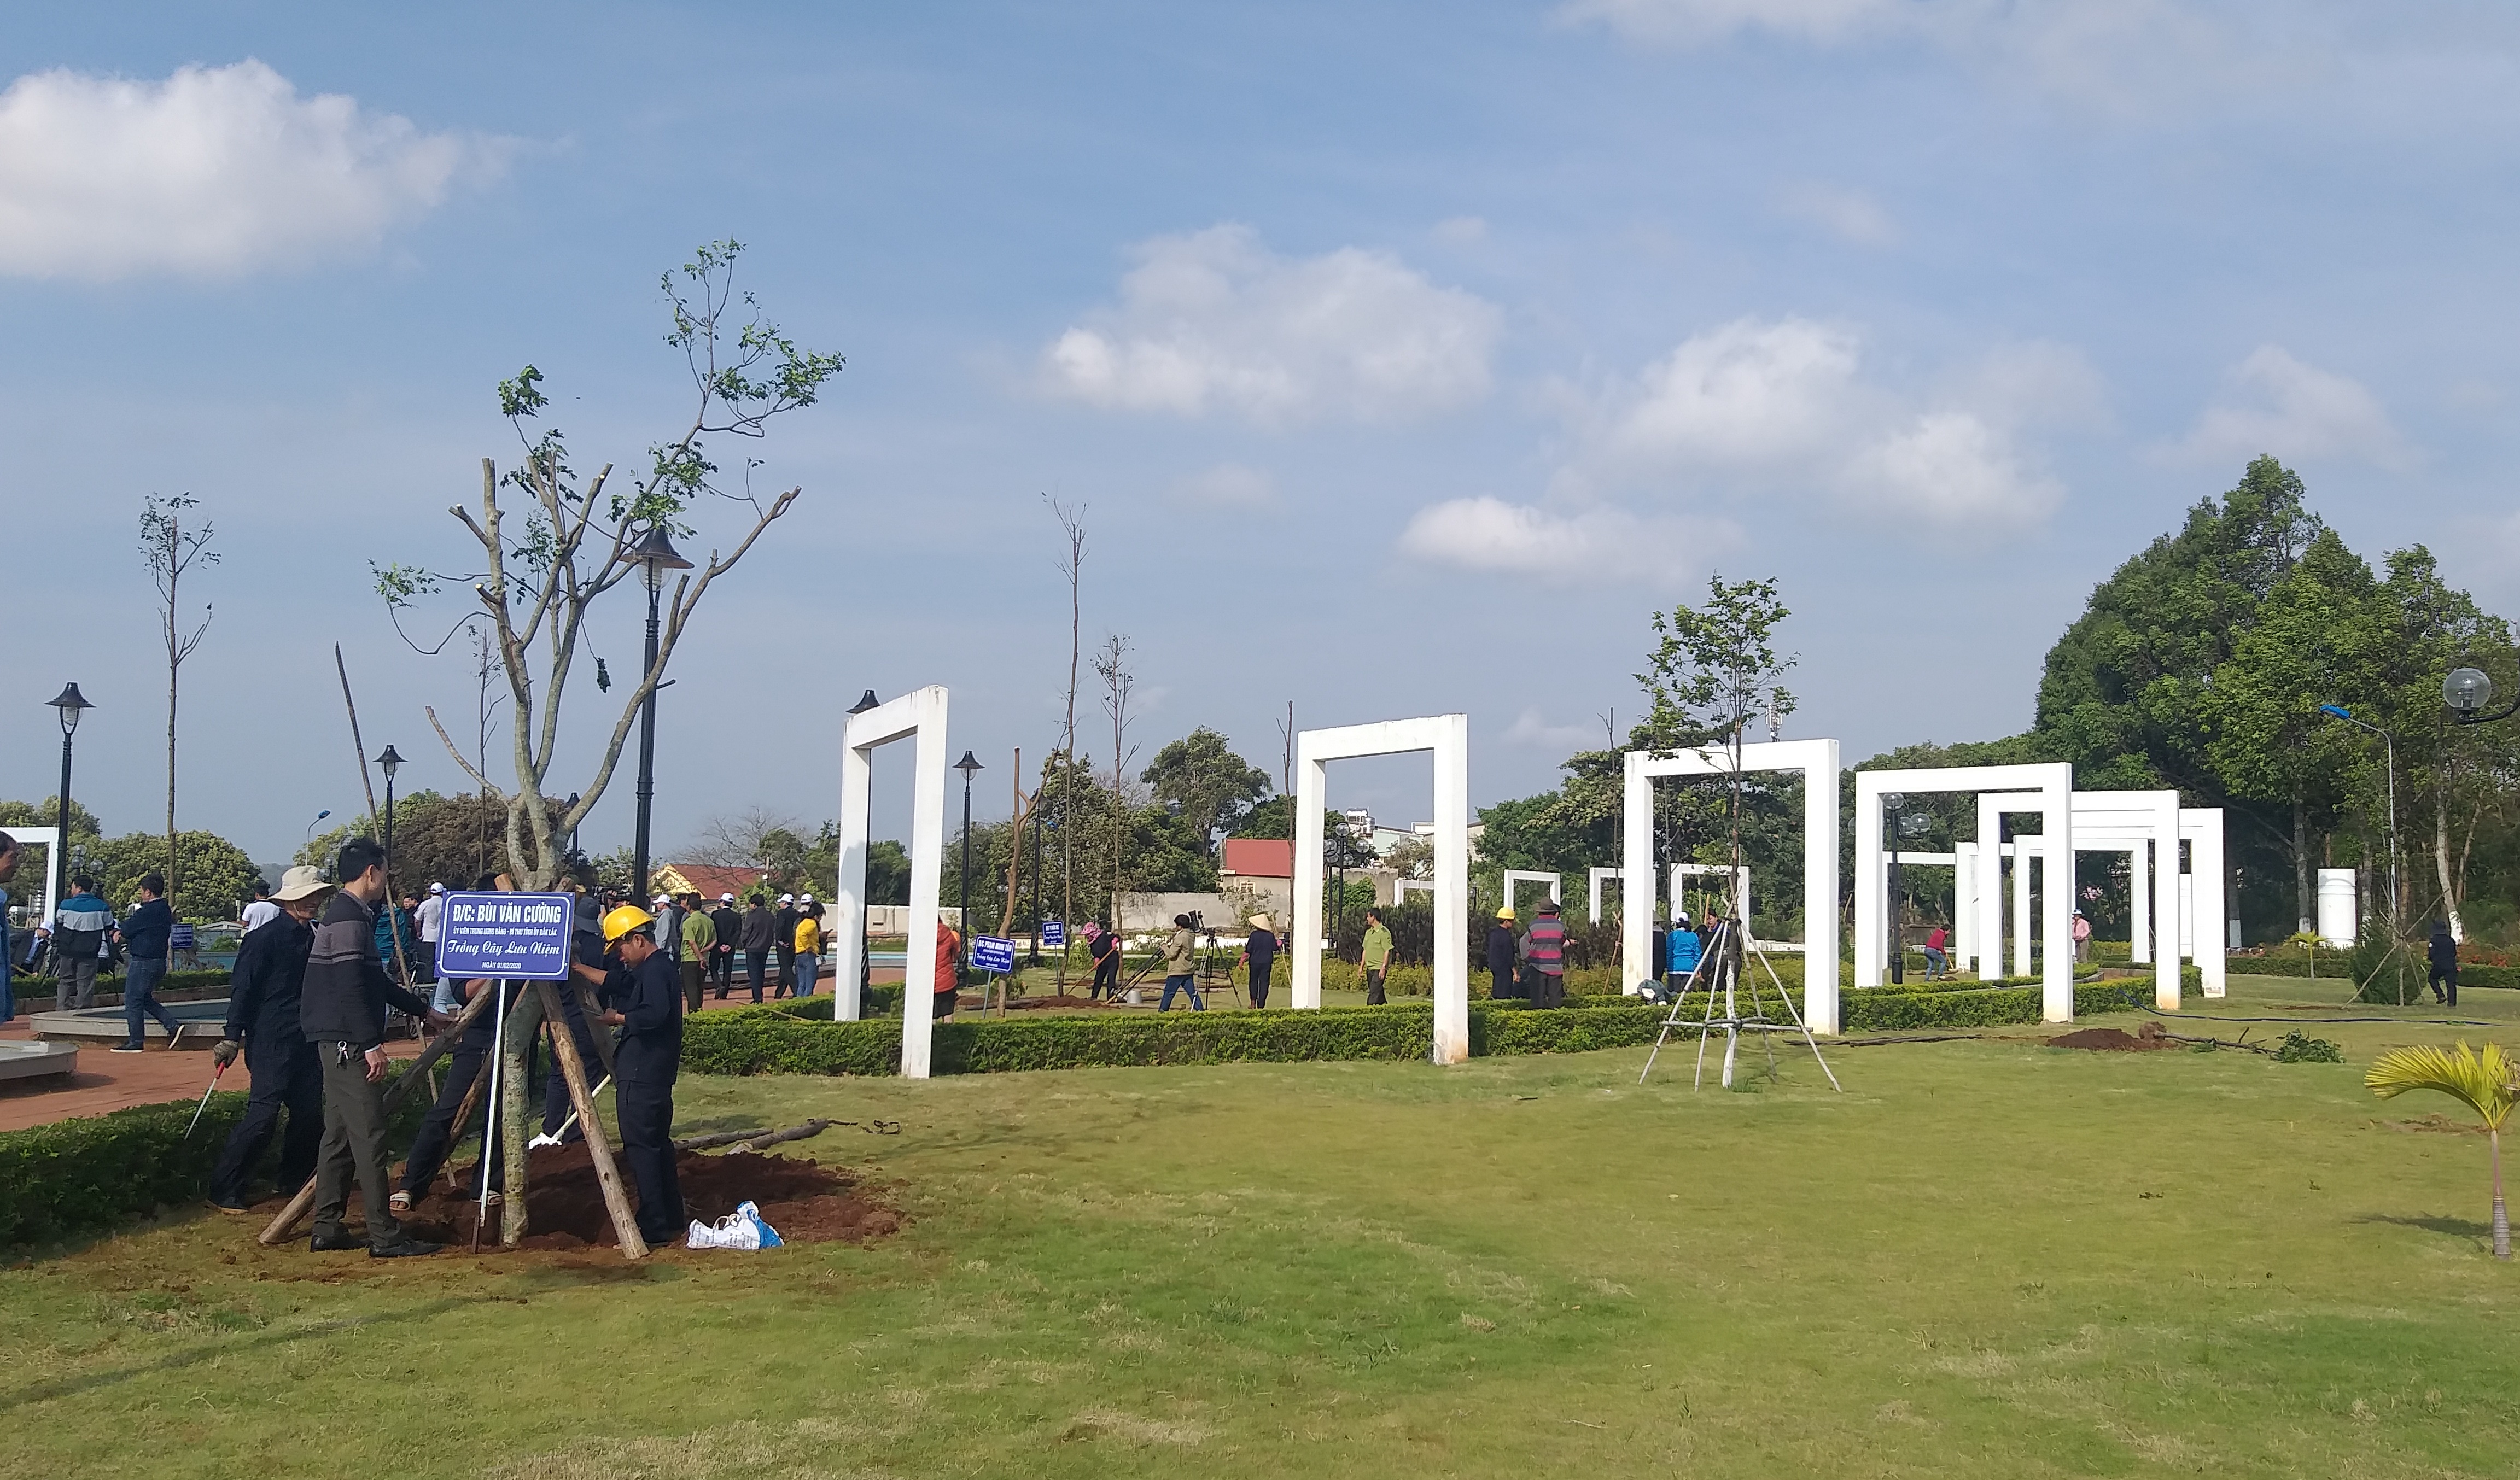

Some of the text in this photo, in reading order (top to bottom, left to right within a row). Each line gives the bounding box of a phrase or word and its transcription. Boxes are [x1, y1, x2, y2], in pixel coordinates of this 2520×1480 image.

[453, 902, 562, 923] Đ/C: BÙI VĂN CƯỜNG
[447, 939, 560, 958] Trồng Cây Lưu Niệm
[497, 961, 522, 969] 01/02/2020
